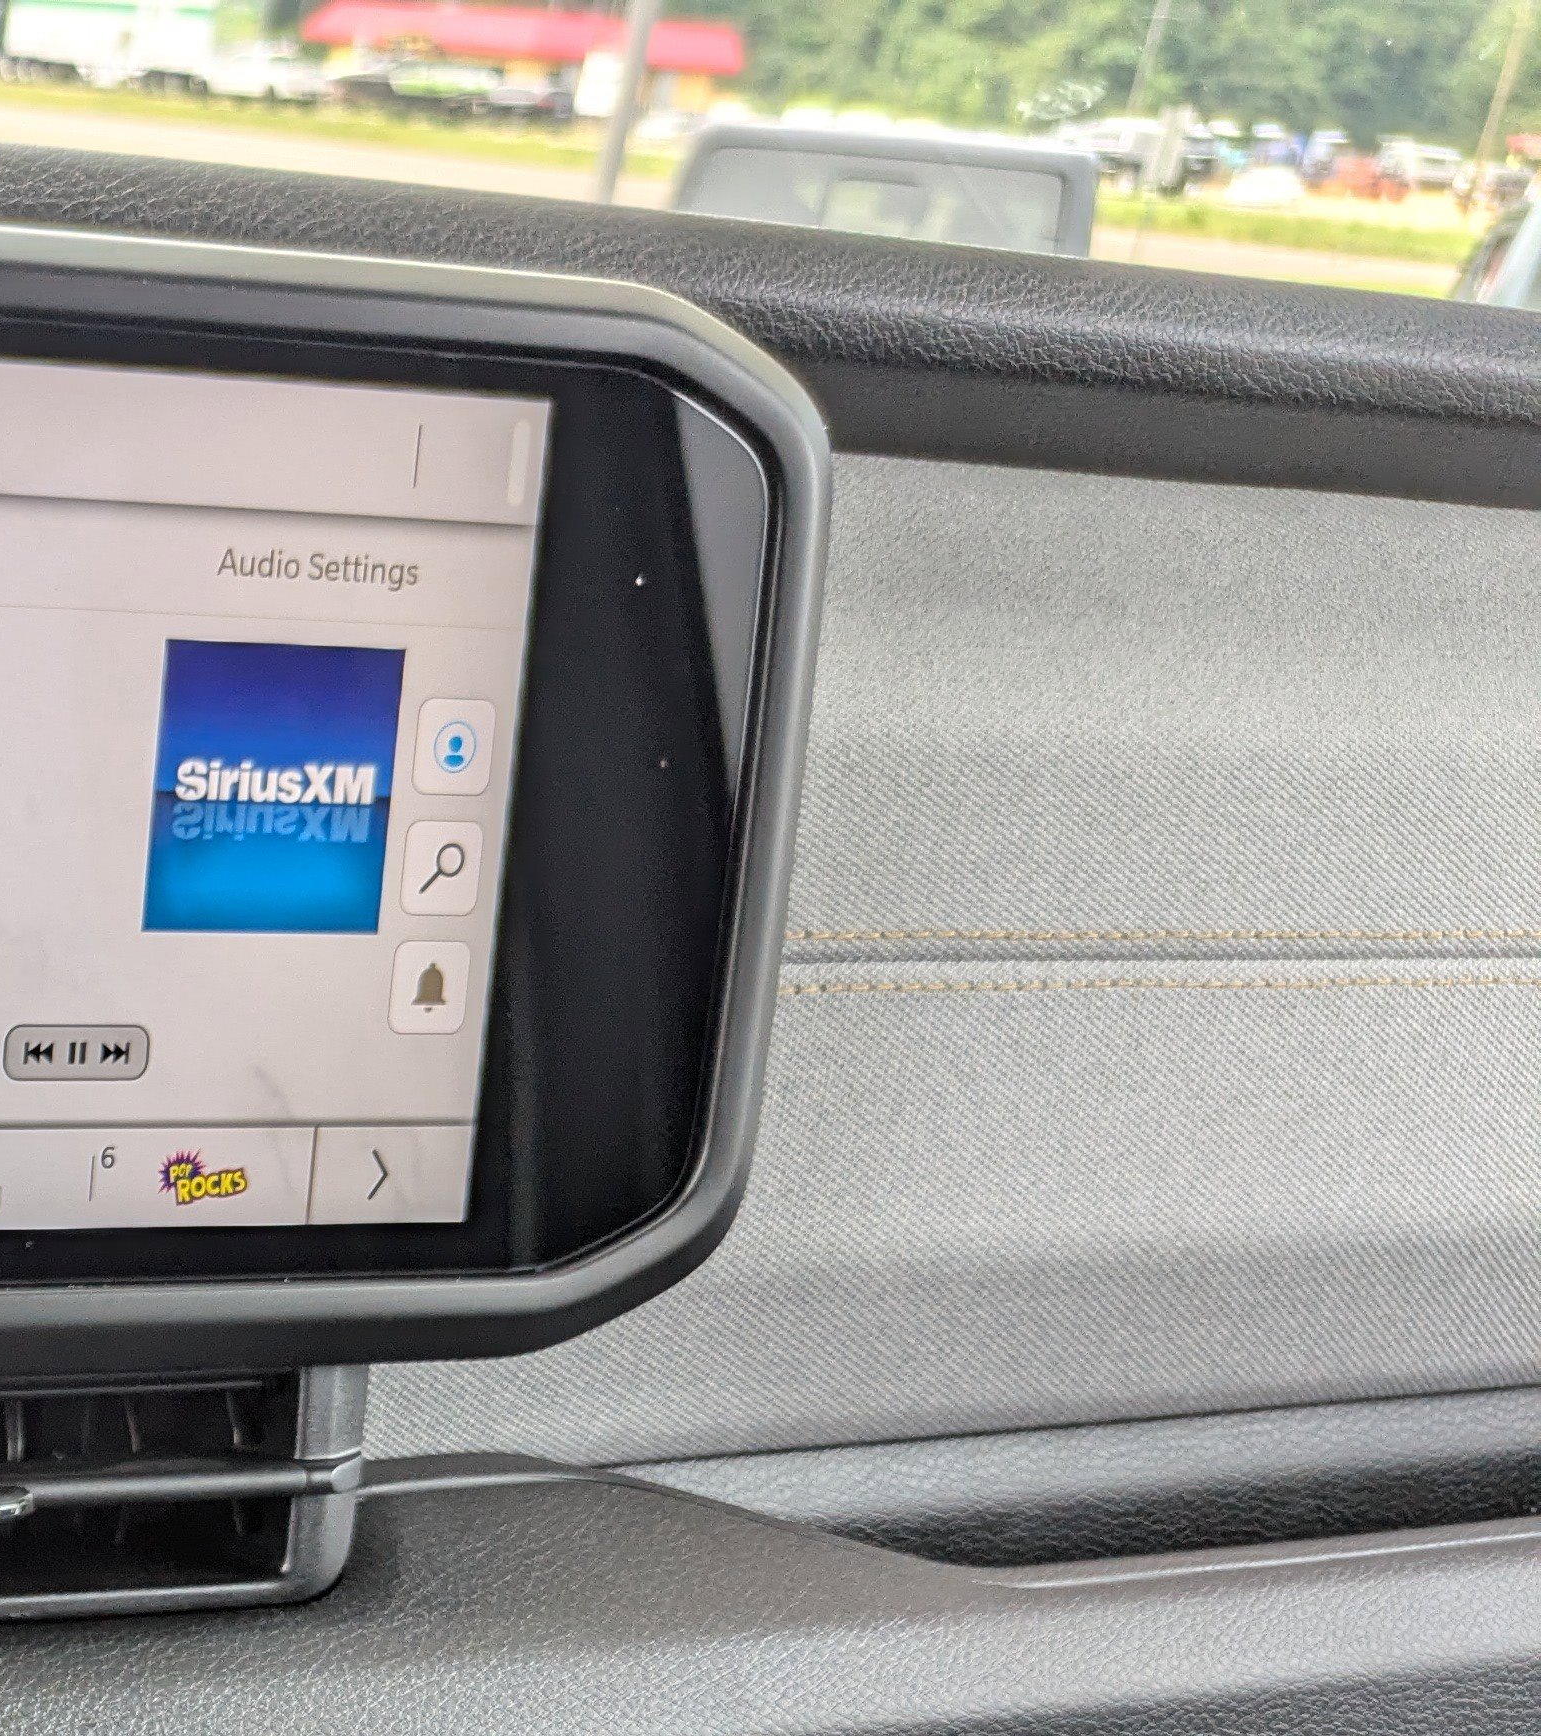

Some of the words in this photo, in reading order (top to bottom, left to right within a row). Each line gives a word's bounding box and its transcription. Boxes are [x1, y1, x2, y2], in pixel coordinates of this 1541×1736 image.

[217, 548, 301, 581] Audio
[307, 553, 419, 592] Settings
[174, 758, 376, 805] SiriusXM
[101, 1146, 117, 1169] 6
[176, 1170, 247, 1204] ROCKS
